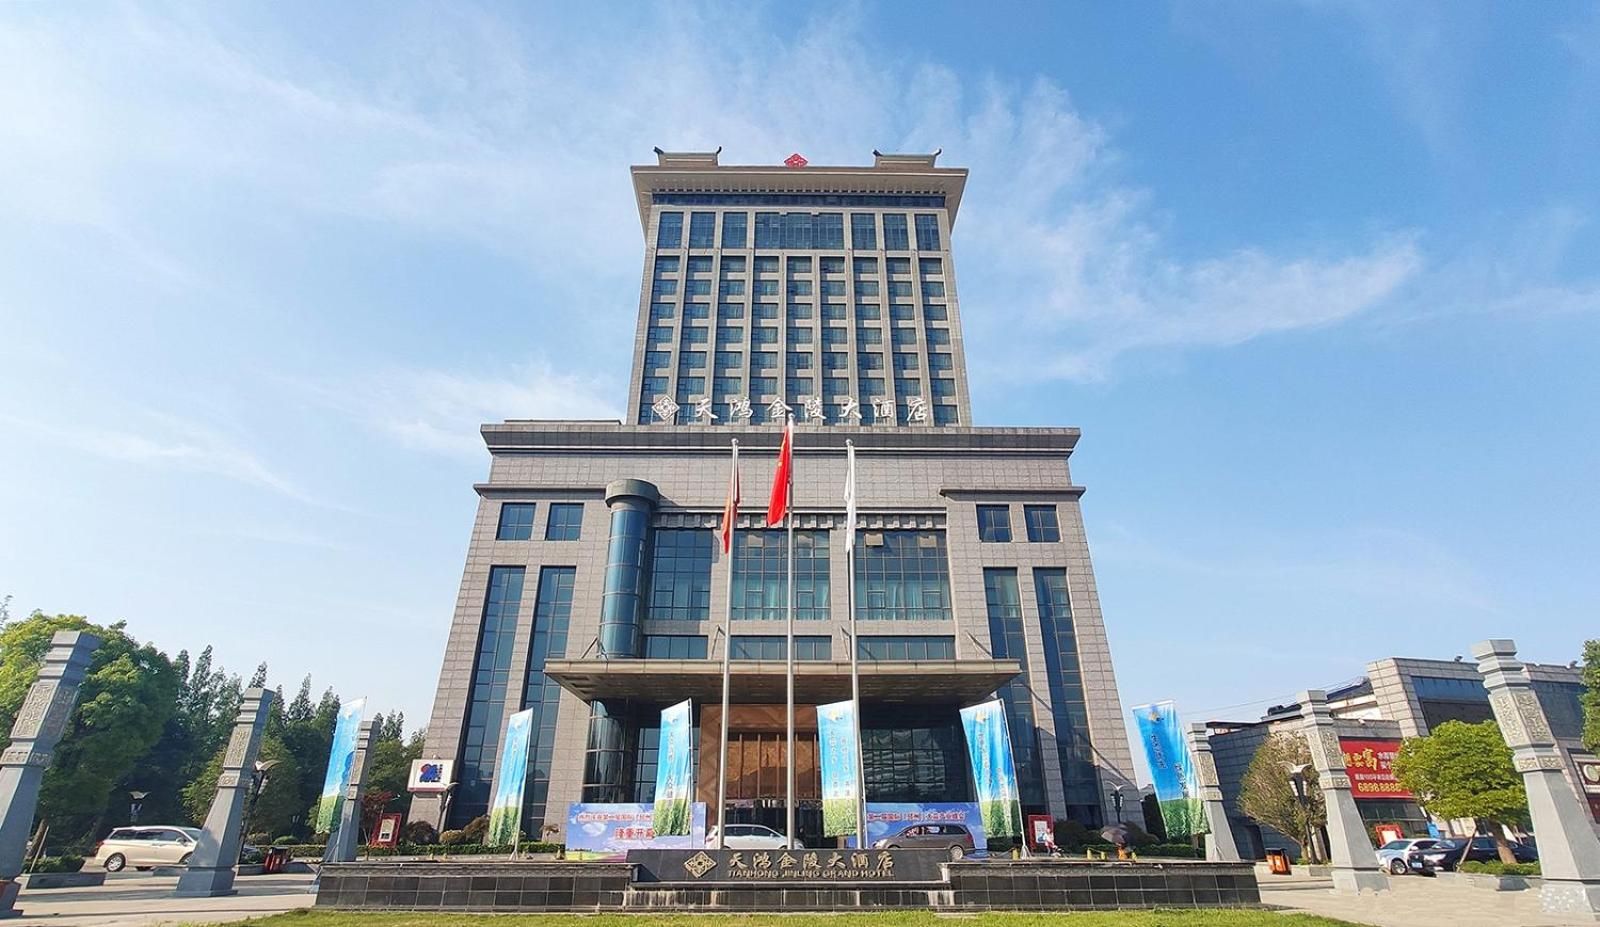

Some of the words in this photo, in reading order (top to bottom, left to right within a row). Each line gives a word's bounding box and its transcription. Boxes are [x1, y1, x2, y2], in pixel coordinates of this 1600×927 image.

[695, 398, 928, 422] 天鸿金陵大酒店
[729, 851, 894, 869] 天鸿金陵大酒店
[728, 869, 779, 878] TIANHONG
[781, 869, 820, 879] JINLING
[822, 869, 859, 878] GRAND
[861, 869, 894, 878] HOTEL
